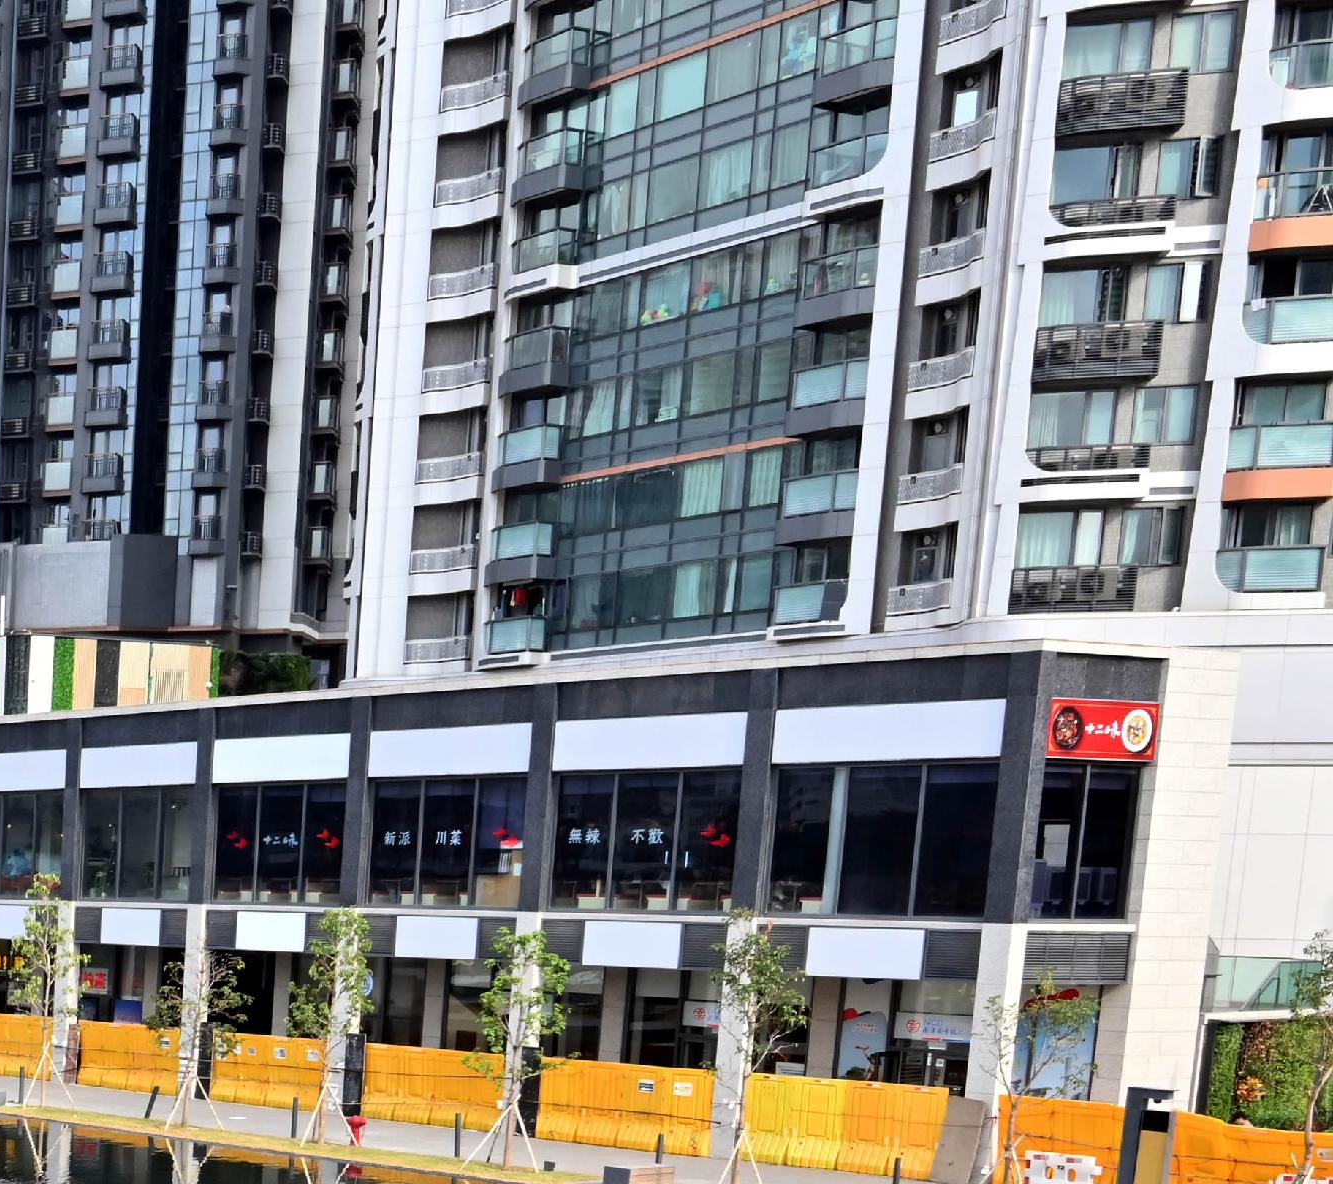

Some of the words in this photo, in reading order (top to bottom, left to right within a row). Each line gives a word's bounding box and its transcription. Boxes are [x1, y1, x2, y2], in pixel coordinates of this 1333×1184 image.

[1084, 720, 1121, 739] 十二味
[262, 832, 299, 848] 十二味
[384, 831, 411, 846] 新派
[435, 829, 463, 846] 川菜
[568, 828, 601, 845] 無辣
[631, 828, 664, 844] 不歡
